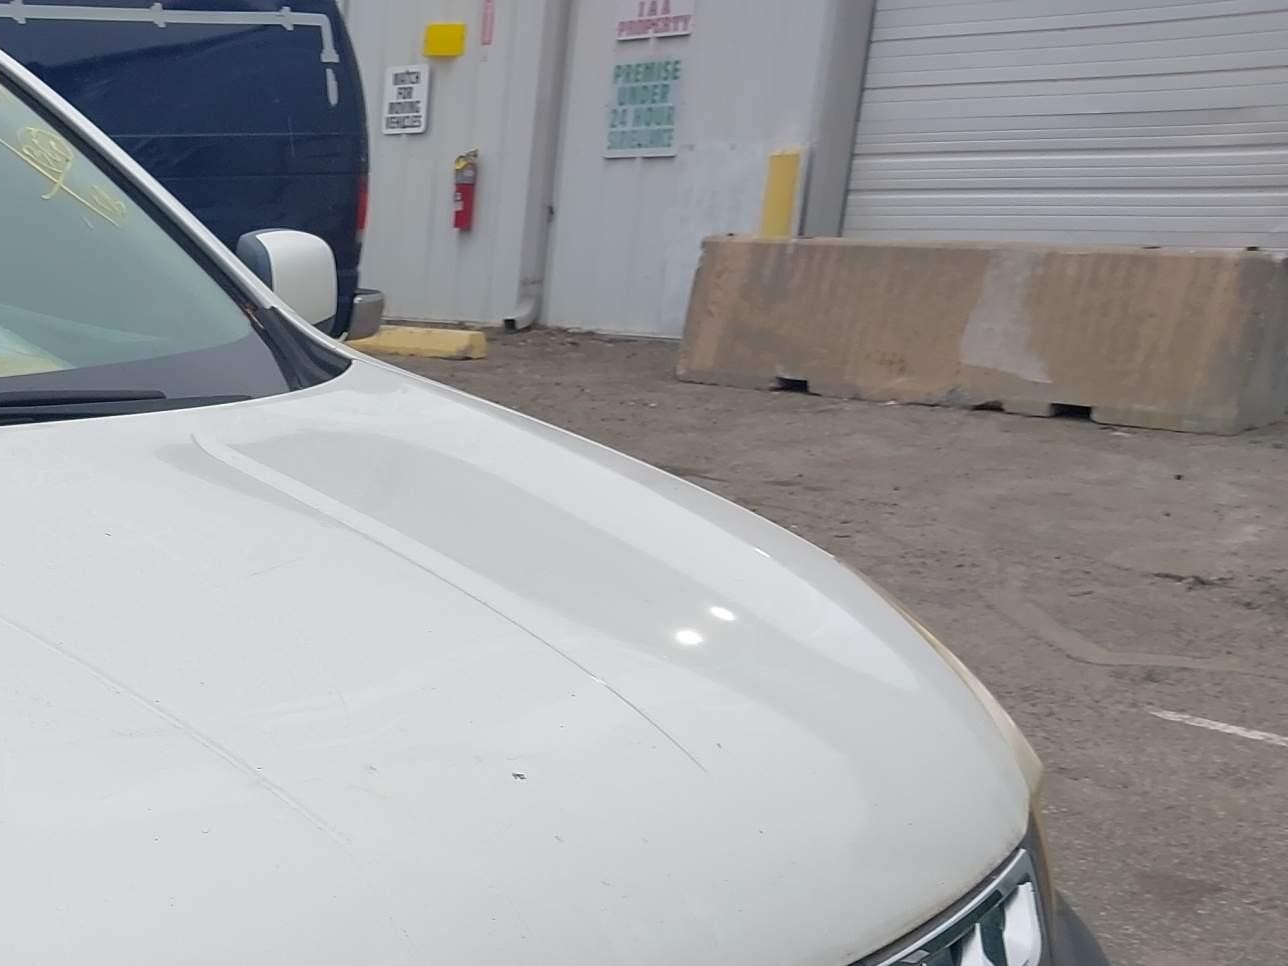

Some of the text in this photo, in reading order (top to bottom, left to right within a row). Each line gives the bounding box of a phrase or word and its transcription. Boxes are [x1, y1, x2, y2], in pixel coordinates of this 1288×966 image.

[392, 72, 421, 85] WATCH
[614, 60, 681, 84] PREMISE
[397, 87, 413, 99] FOR
[617, 84, 671, 106] UNDER
[388, 101, 420, 114] MOVING
[609, 106, 674, 128] 24 HOUR
